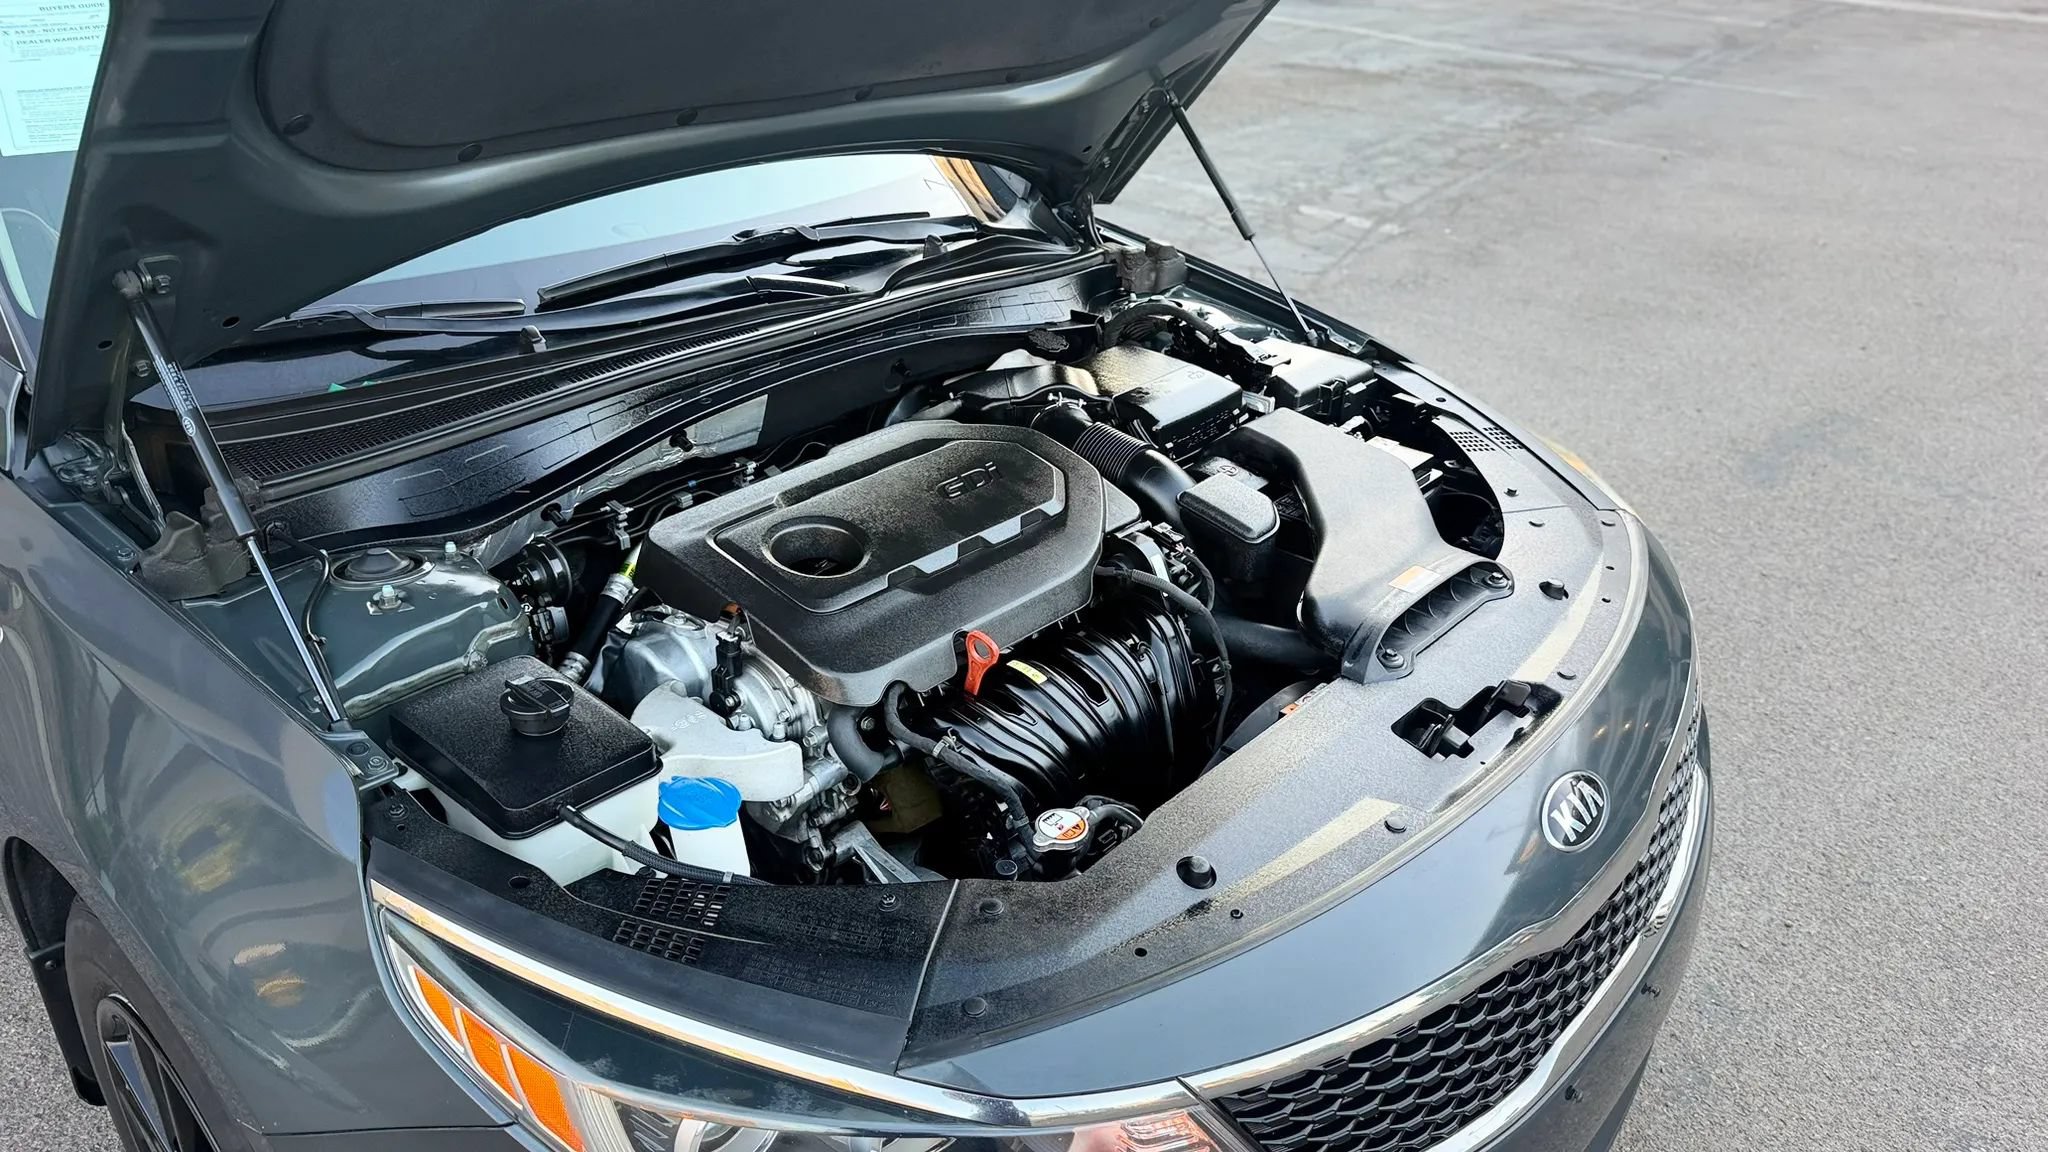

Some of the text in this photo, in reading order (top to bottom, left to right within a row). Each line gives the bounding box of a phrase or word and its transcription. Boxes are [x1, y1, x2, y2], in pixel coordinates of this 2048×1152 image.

[39, 4, 76, 12] BUYERS
[16, 35, 100, 46] DEALER WARRANTY
[1550, 780, 1604, 843] KIA
